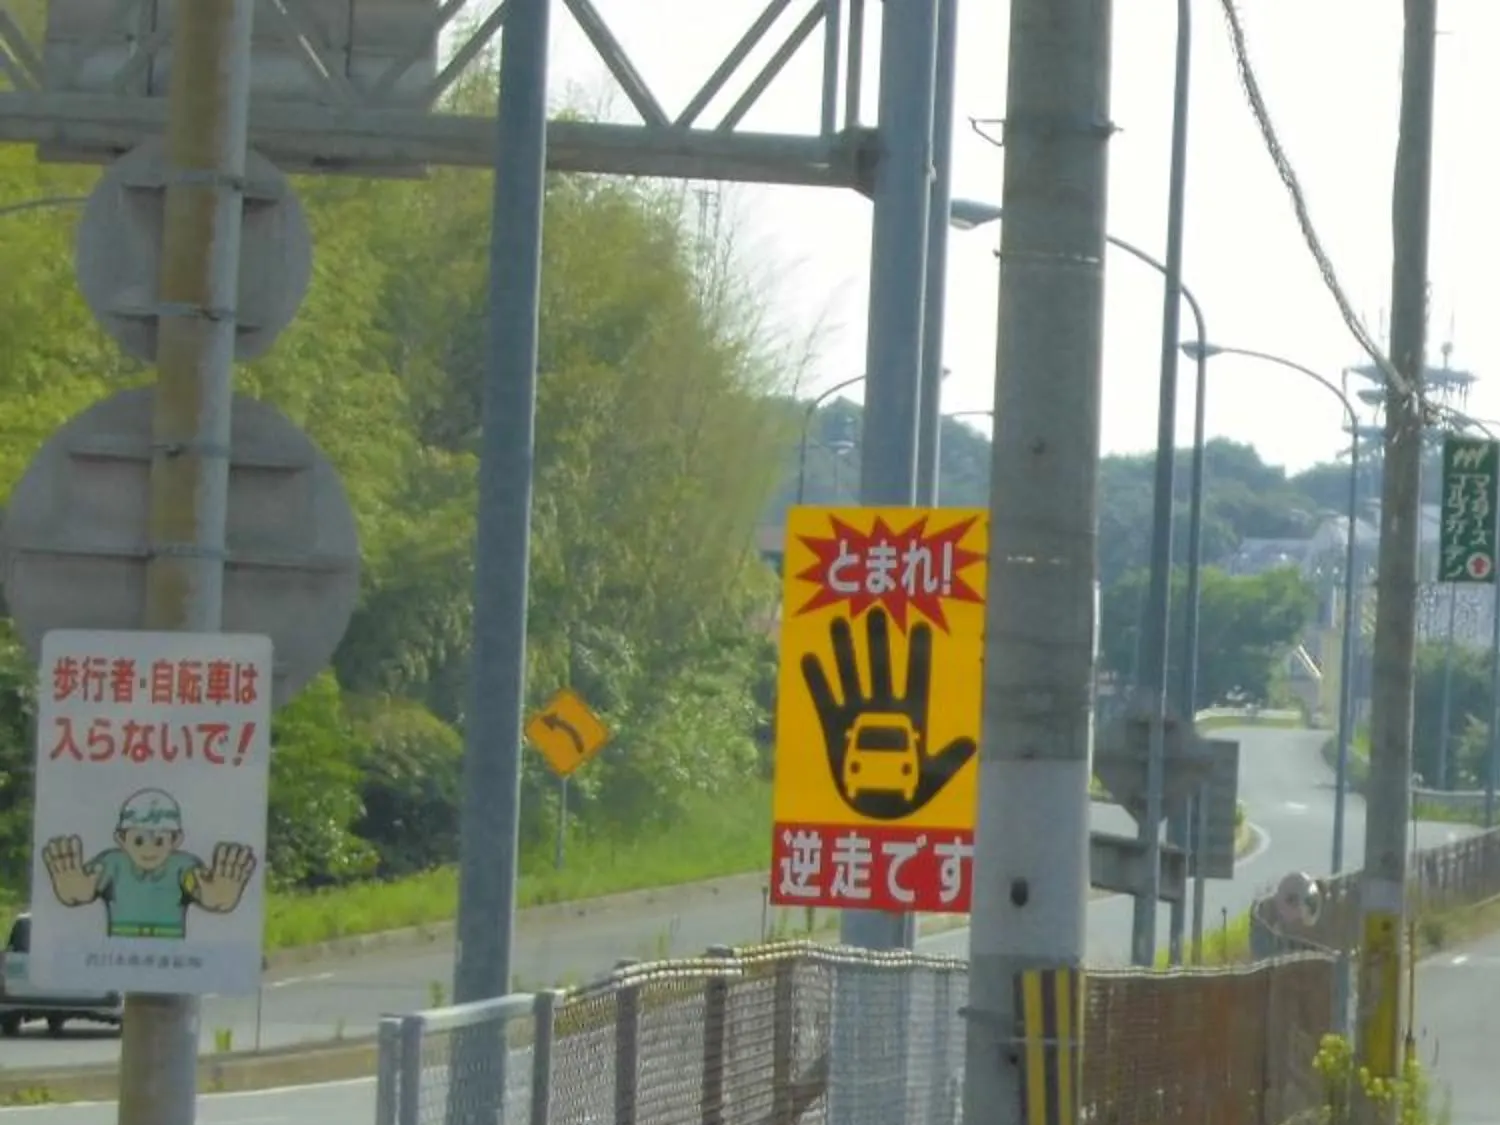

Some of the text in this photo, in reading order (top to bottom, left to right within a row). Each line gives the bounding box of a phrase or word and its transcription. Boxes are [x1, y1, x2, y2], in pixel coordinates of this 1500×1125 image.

[828, 539, 953, 596] とまれ!
[50, 717, 257, 767] 入らないで!
[779, 830, 974, 904] 逆走です
